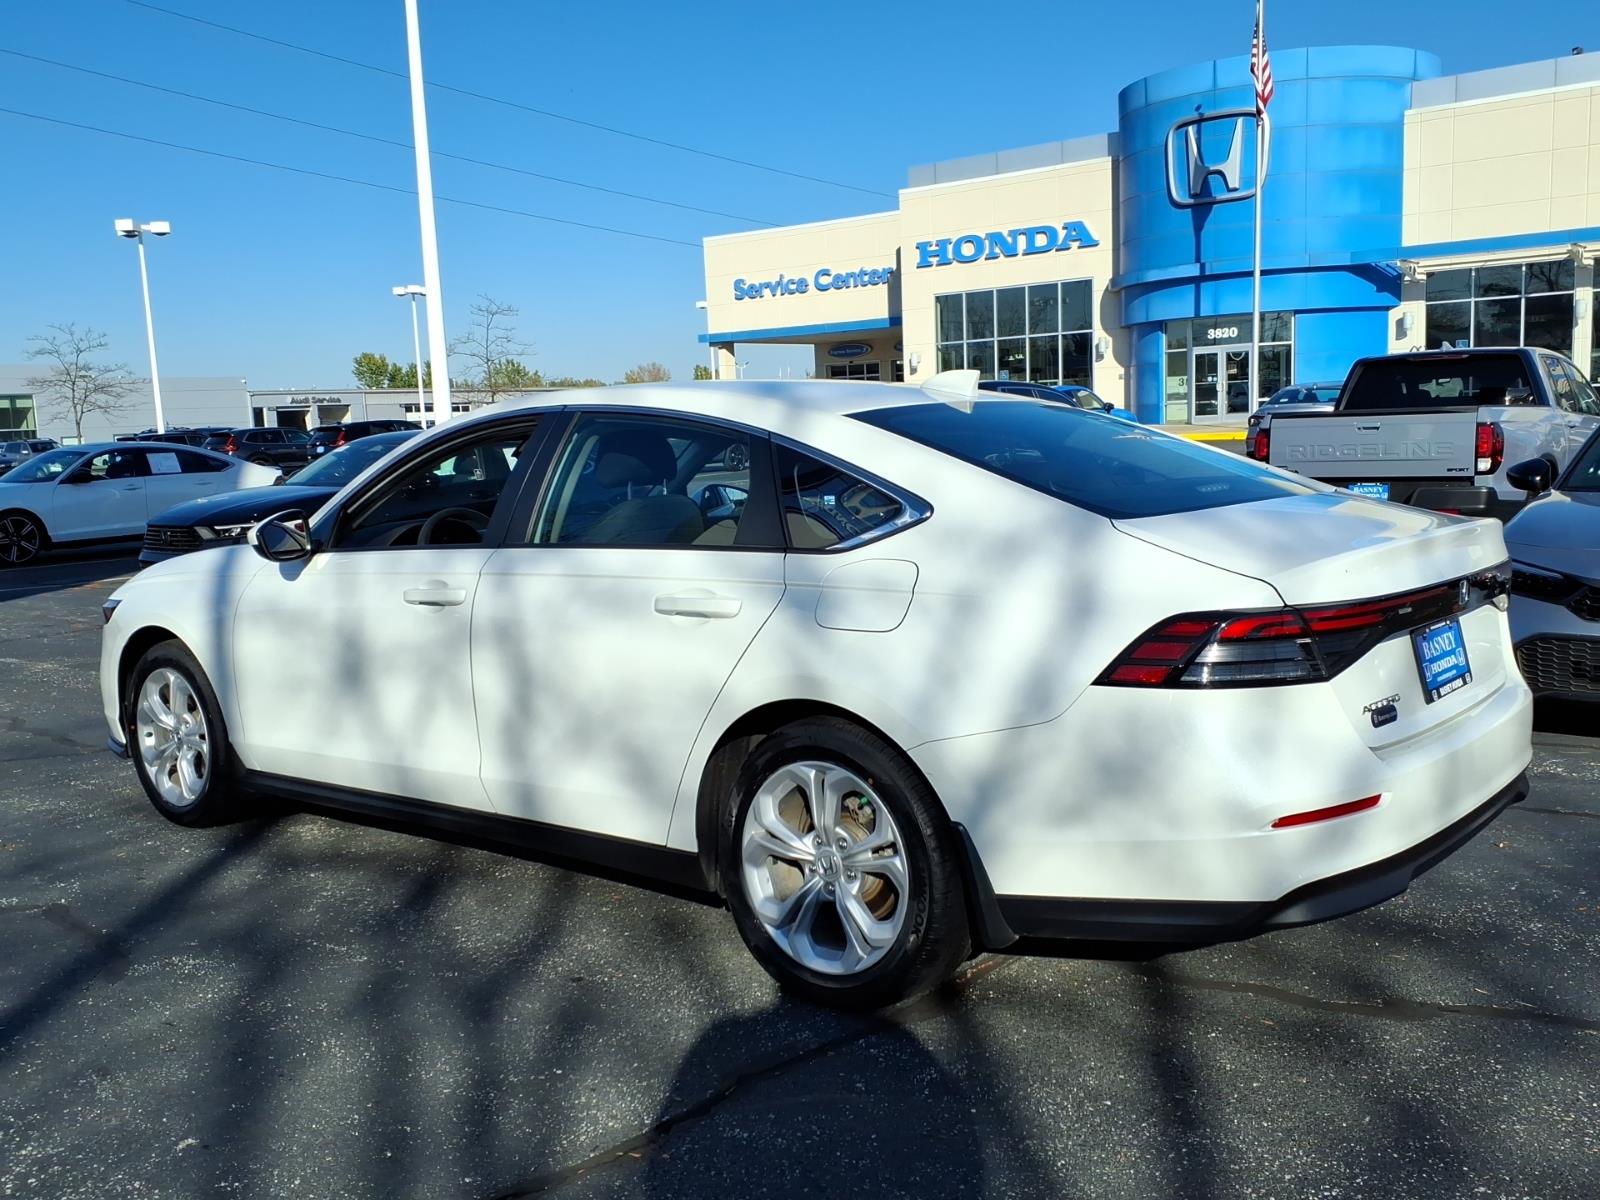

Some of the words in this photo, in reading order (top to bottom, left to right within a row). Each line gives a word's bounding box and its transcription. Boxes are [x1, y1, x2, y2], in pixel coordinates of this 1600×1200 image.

[915, 220, 1101, 269] HONDA
[733, 273, 809, 301] Service
[813, 265, 893, 292] Center
[1207, 326, 1238, 339] 3820
[290, 396, 310, 404] Audi
[311, 396, 342, 404] Service
[1287, 440, 1455, 459] RIDGELINE
[1353, 486, 1384, 494] BASNEY
[1422, 630, 1456, 660] BASNEY
[1430, 654, 1458, 674] HONDA
